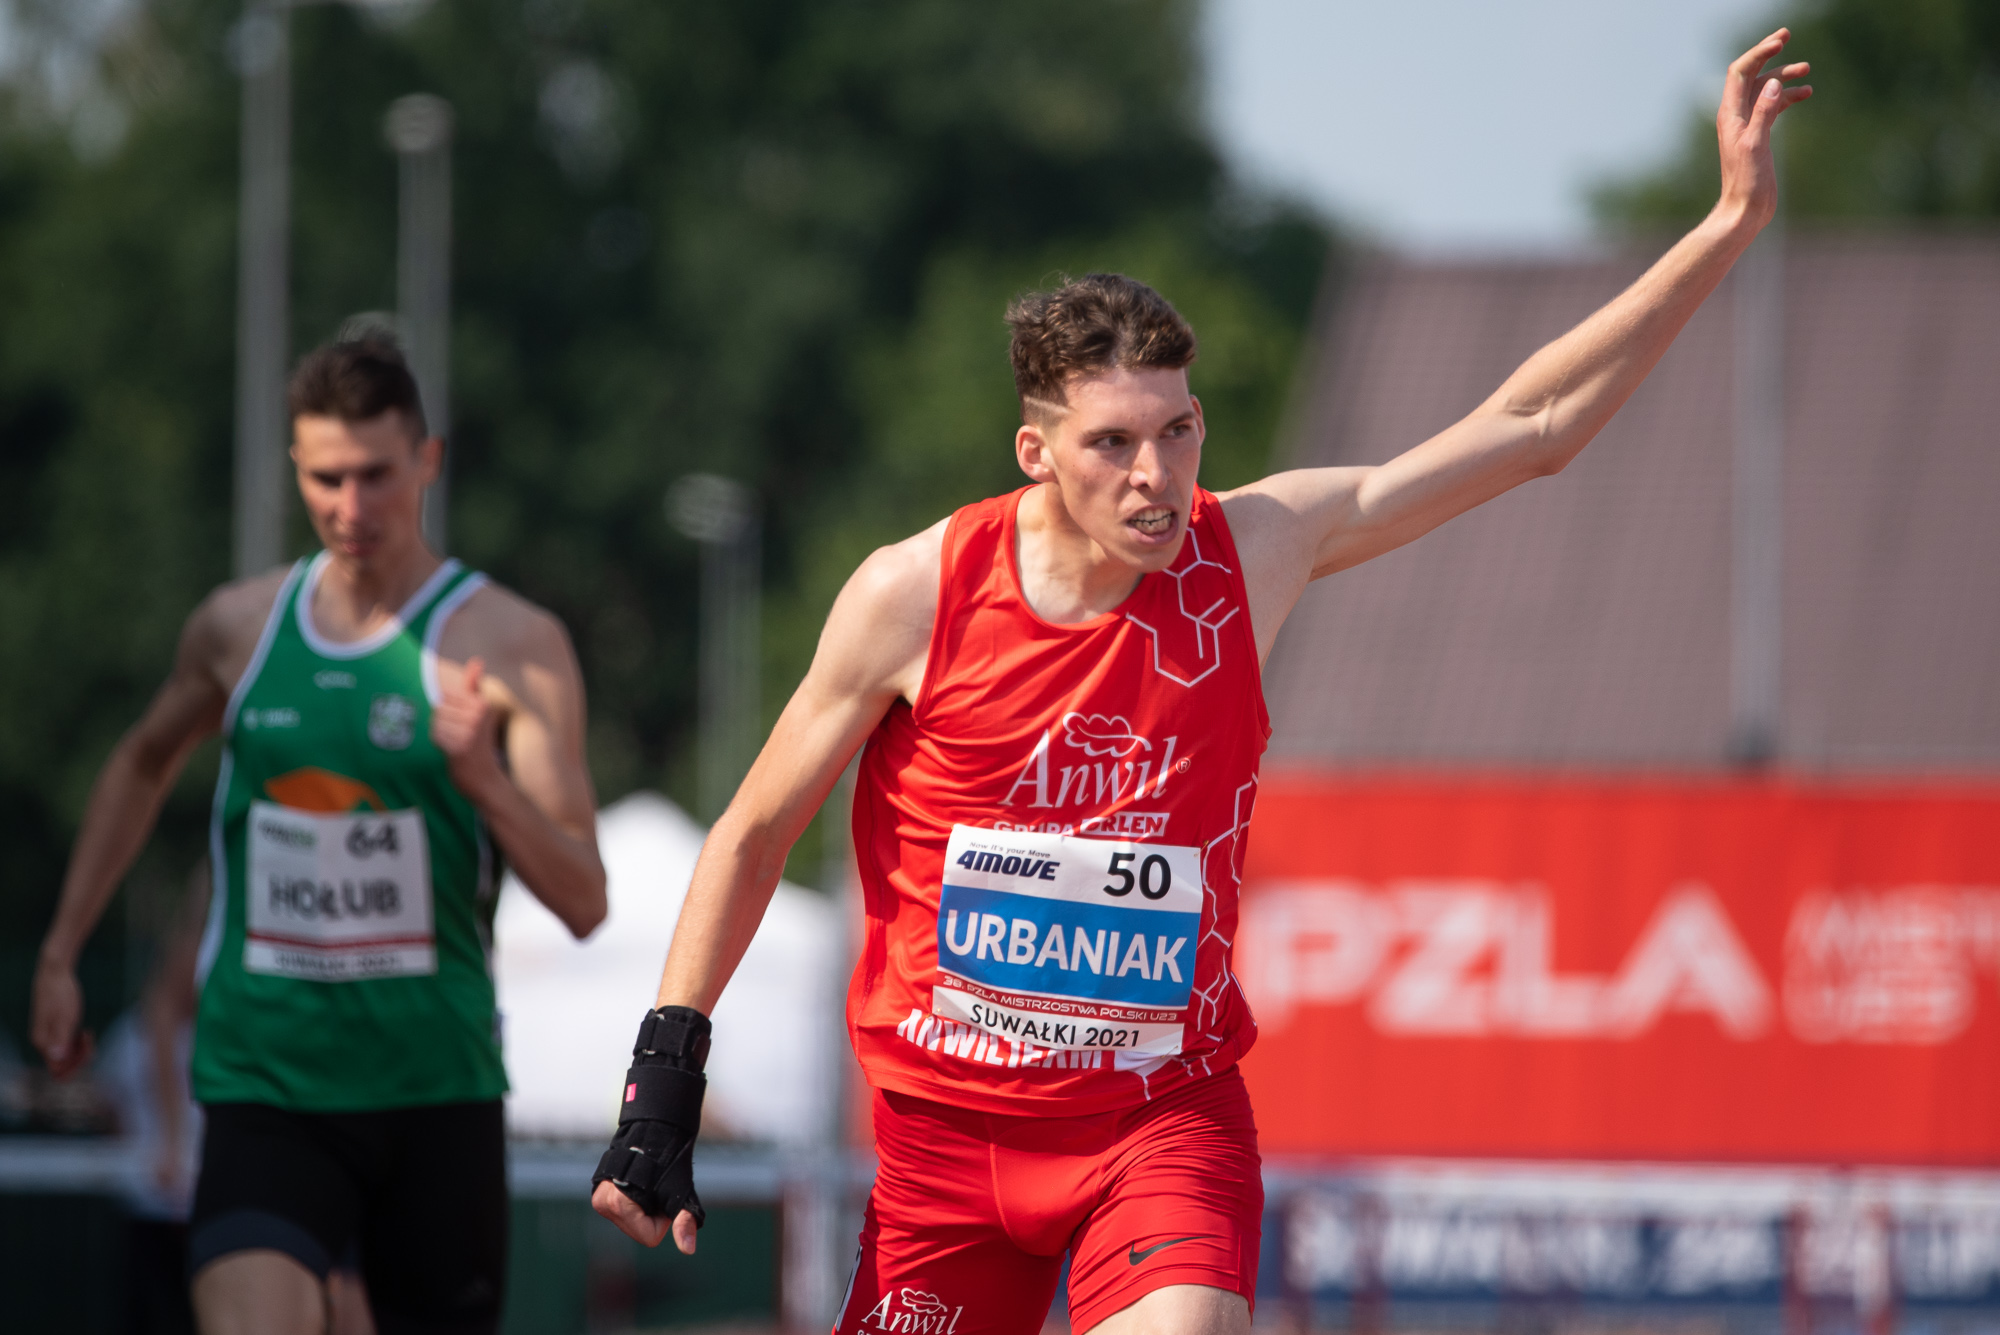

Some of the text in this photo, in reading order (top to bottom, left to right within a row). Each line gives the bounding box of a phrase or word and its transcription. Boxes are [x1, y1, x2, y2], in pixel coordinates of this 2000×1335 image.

[995, 728, 1178, 809] Anwil
[346, 820, 399, 858] 64
[1085, 814, 1164, 834] ORLEN
[956, 849, 1061, 881] 4MOVE
[1006, 847, 1026, 855] your
[1028, 848, 1051, 859] Move
[1103, 853, 1172, 900] 50
[945, 908, 1188, 984] URBANIAK
[1240, 877, 1777, 1041] PZLA
[943, 975, 1177, 1022] 38. PZLA MISTRZOSTWA POLSKI U23
[969, 1003, 1140, 1048] SUWAŁKI 2021
[860, 1290, 964, 1335] Anwil
